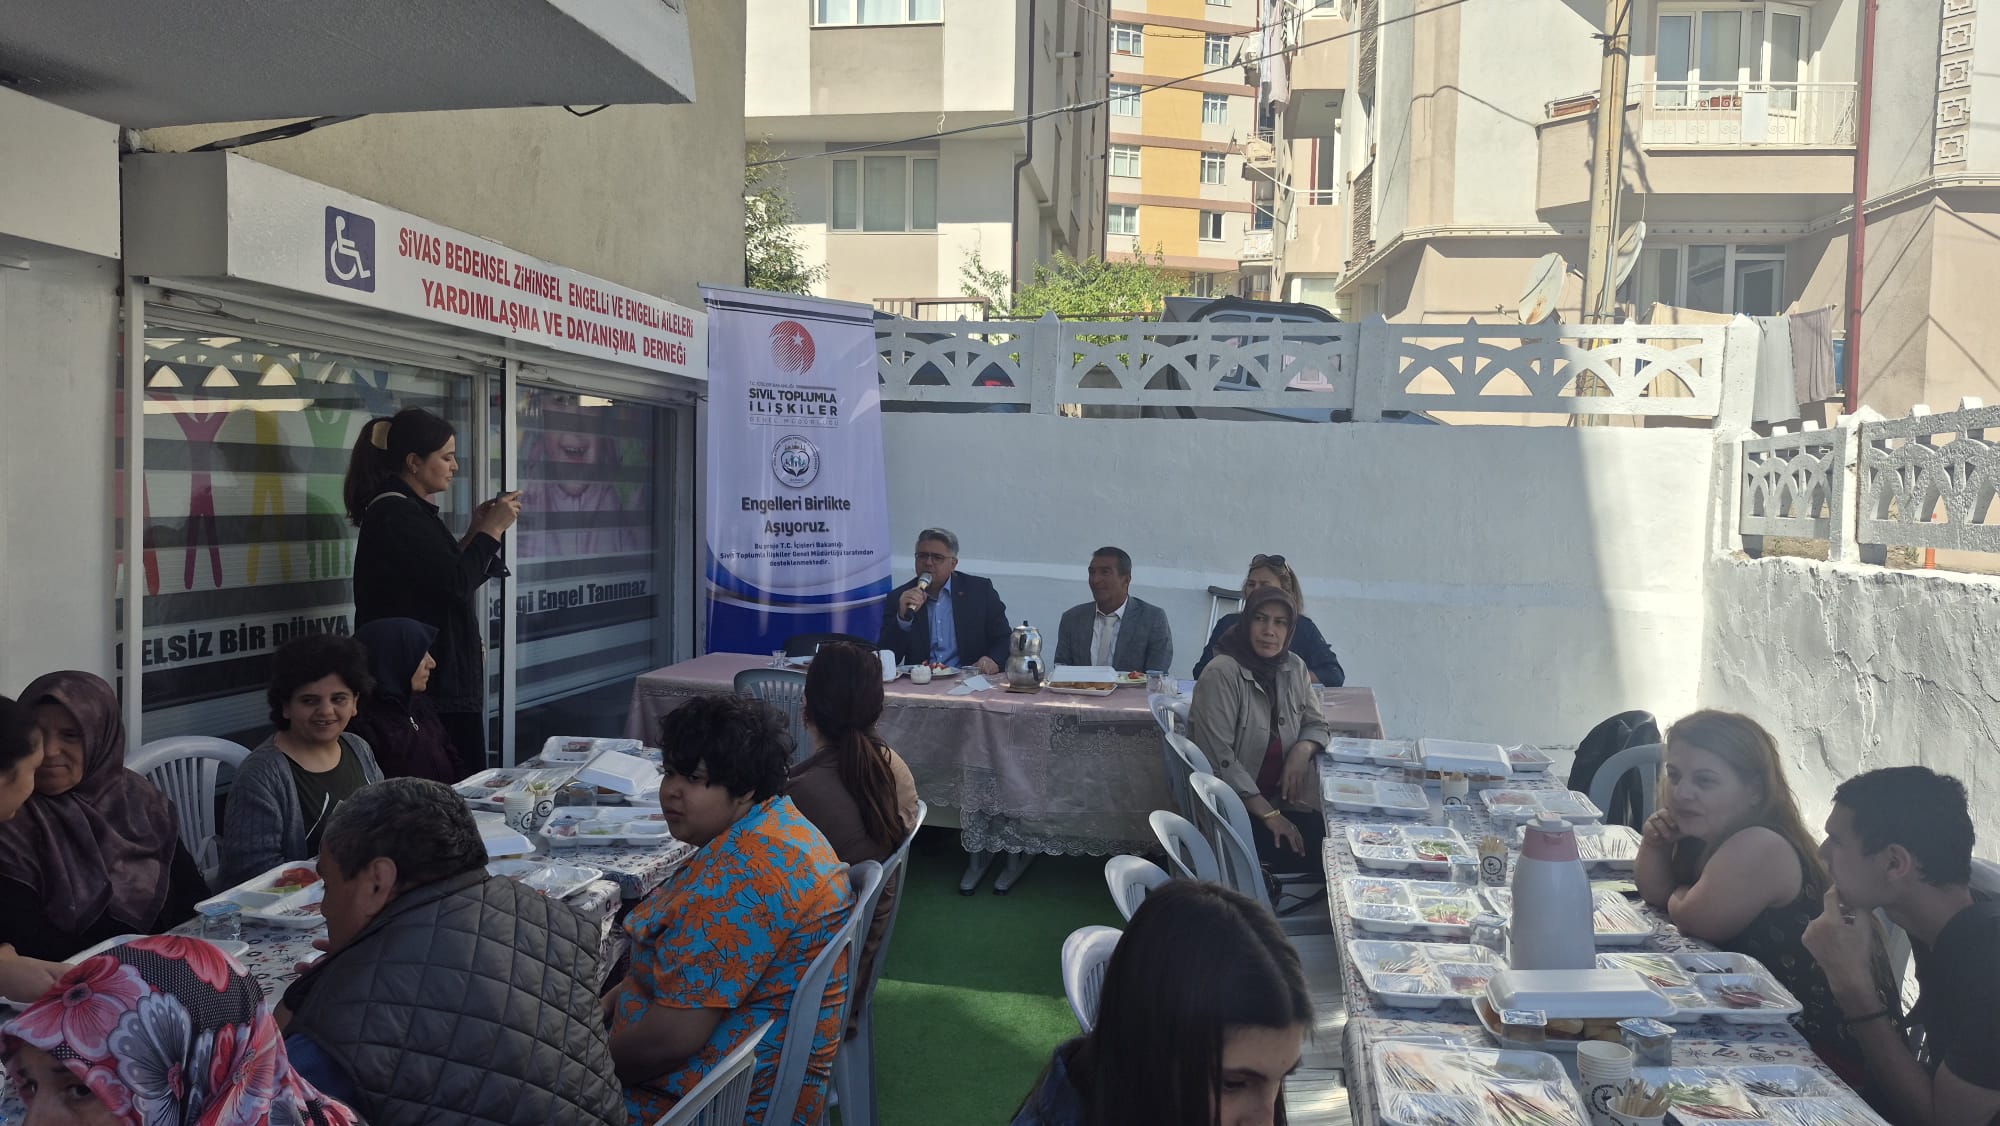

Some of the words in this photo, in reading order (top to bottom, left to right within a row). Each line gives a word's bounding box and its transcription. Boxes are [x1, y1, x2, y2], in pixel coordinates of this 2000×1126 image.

[445, 241, 511, 287] BEDENSEL
[612, 295, 624, 318] VE
[421, 278, 541, 333] YARDIMLAŞMA
[543, 311, 563, 337] VE
[567, 316, 637, 355] DAYANIŞMA
[778, 390, 837, 404] TOPLUMLA
[741, 496, 802, 514] Engelleri
[804, 496, 851, 511] Birlikte
[764, 520, 830, 537] Aşıyoruz.
[538, 585, 583, 610] Engel
[587, 580, 647, 603] Tanımaz
[219, 622, 266, 655] BİR
